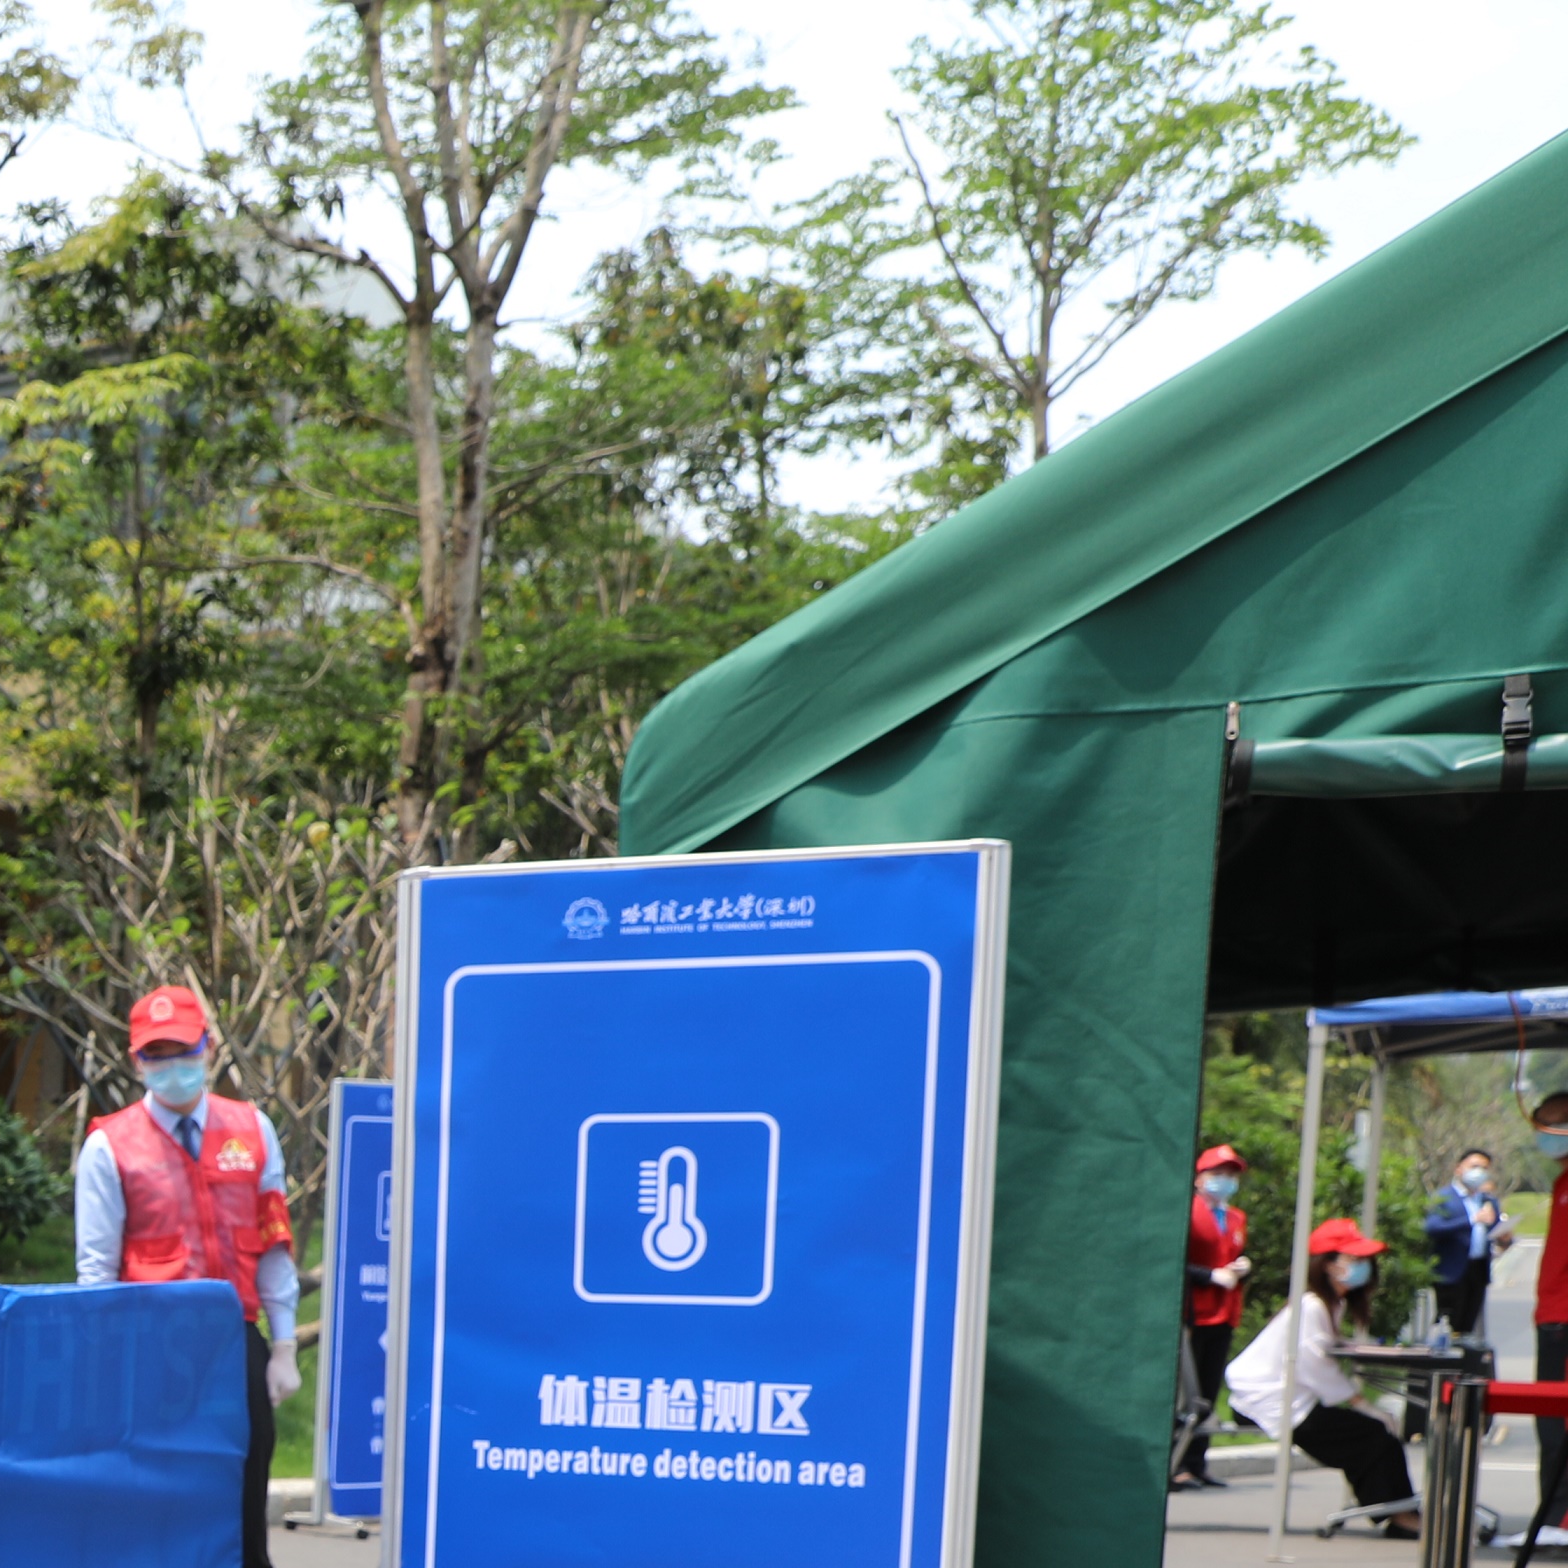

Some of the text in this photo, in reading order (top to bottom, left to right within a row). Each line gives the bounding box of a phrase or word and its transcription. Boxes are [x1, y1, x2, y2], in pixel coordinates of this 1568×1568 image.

[538, 1374, 812, 1436] 体温检测区
[473, 1439, 865, 1488] Temperature detection area
